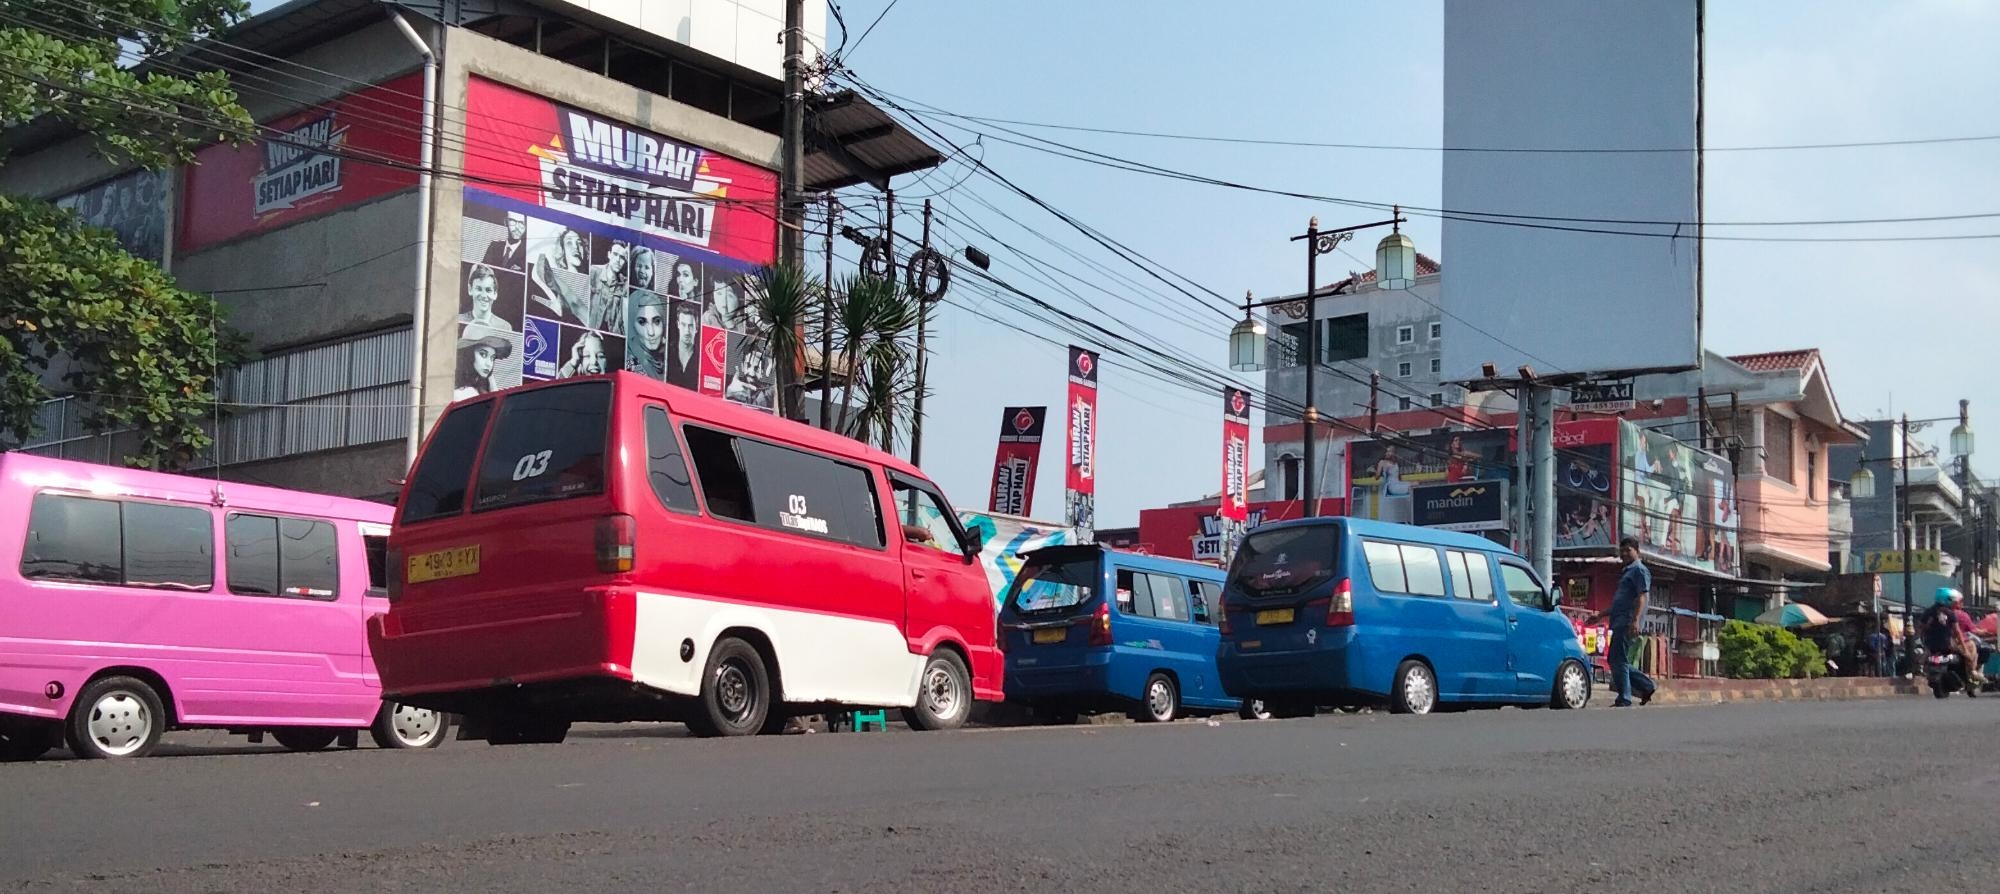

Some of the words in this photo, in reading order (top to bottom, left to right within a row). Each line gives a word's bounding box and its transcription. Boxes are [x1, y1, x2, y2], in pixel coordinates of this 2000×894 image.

[267, 119, 330, 169] MURAH
[568, 112, 697, 181] MURAH
[258, 170, 301, 205] SETIAP
[303, 158, 334, 192] HARI
[552, 167, 641, 220] SETIAP
[644, 196, 704, 239] HARI
[1608, 384, 1630, 398] Ad
[1071, 405, 1082, 465] MURAH
[1083, 407, 1091, 432] HARI
[512, 449, 553, 481] 03
[1083, 435, 1091, 474] SETIAP
[1227, 443, 1236, 496] MURAH
[1014, 463, 1026, 489] HARI
[788, 494, 807, 515] 03
[410, 557, 417, 573] F
